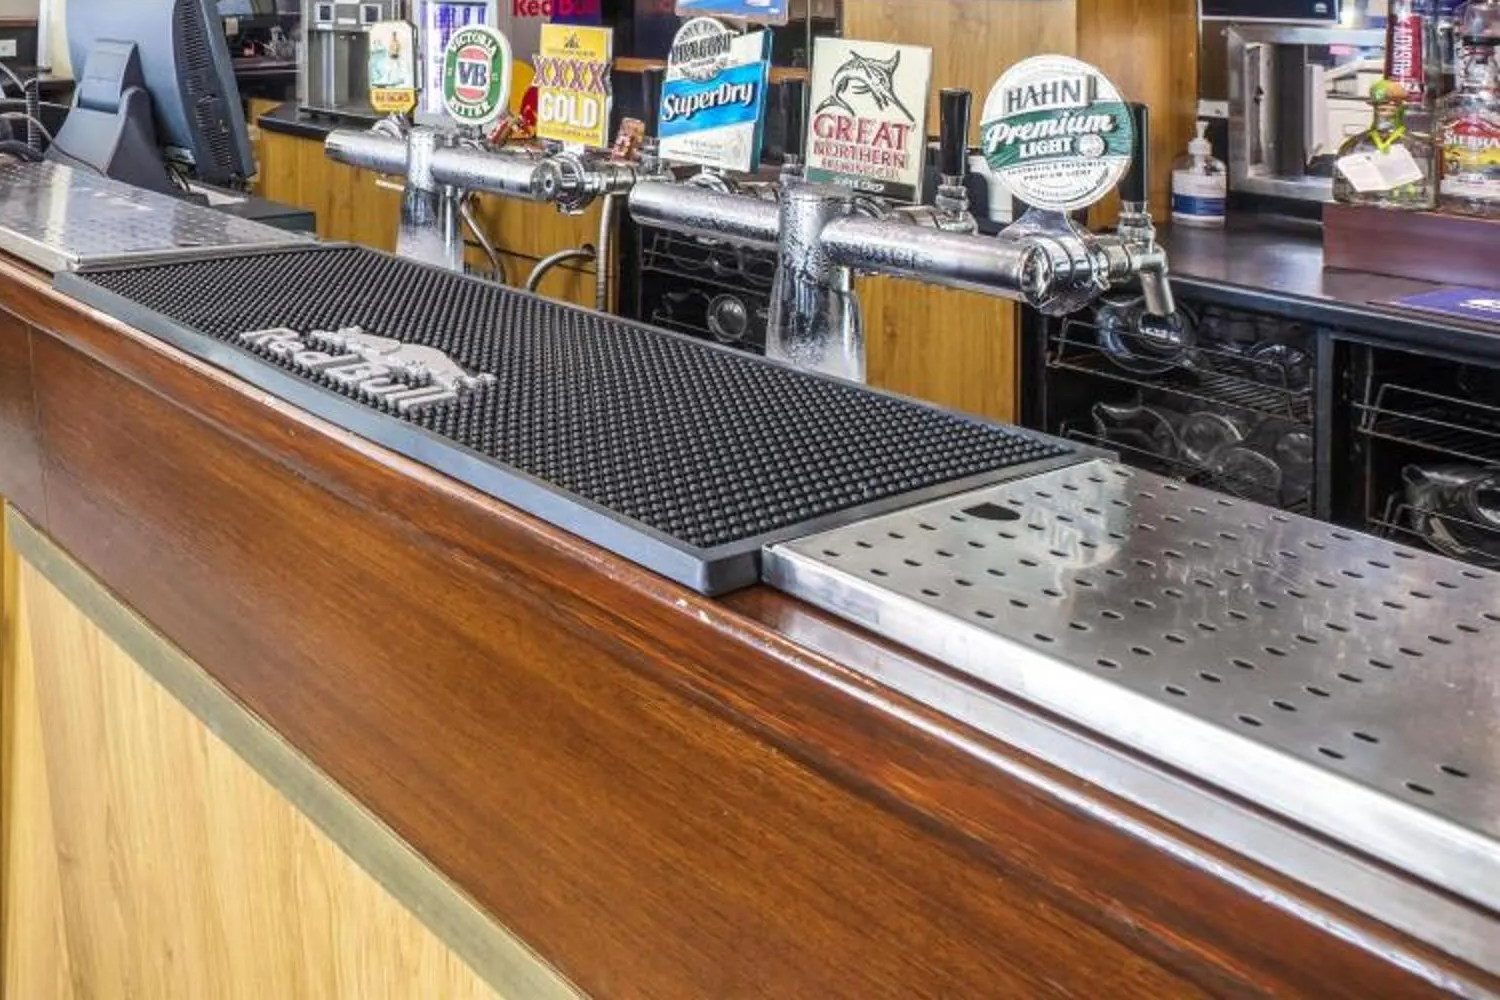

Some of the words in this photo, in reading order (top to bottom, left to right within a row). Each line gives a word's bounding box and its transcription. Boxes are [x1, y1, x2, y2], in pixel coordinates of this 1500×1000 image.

[457, 61, 487, 87] VB
[531, 55, 609, 95] XXXX
[541, 91, 599, 129] GOLD
[1006, 78, 1081, 113] HAHN
[813, 113, 911, 151] GREAT
[984, 111, 1116, 154] Premium
[1019, 136, 1075, 158] LIGHT
[813, 140, 907, 169] NORTHERN
